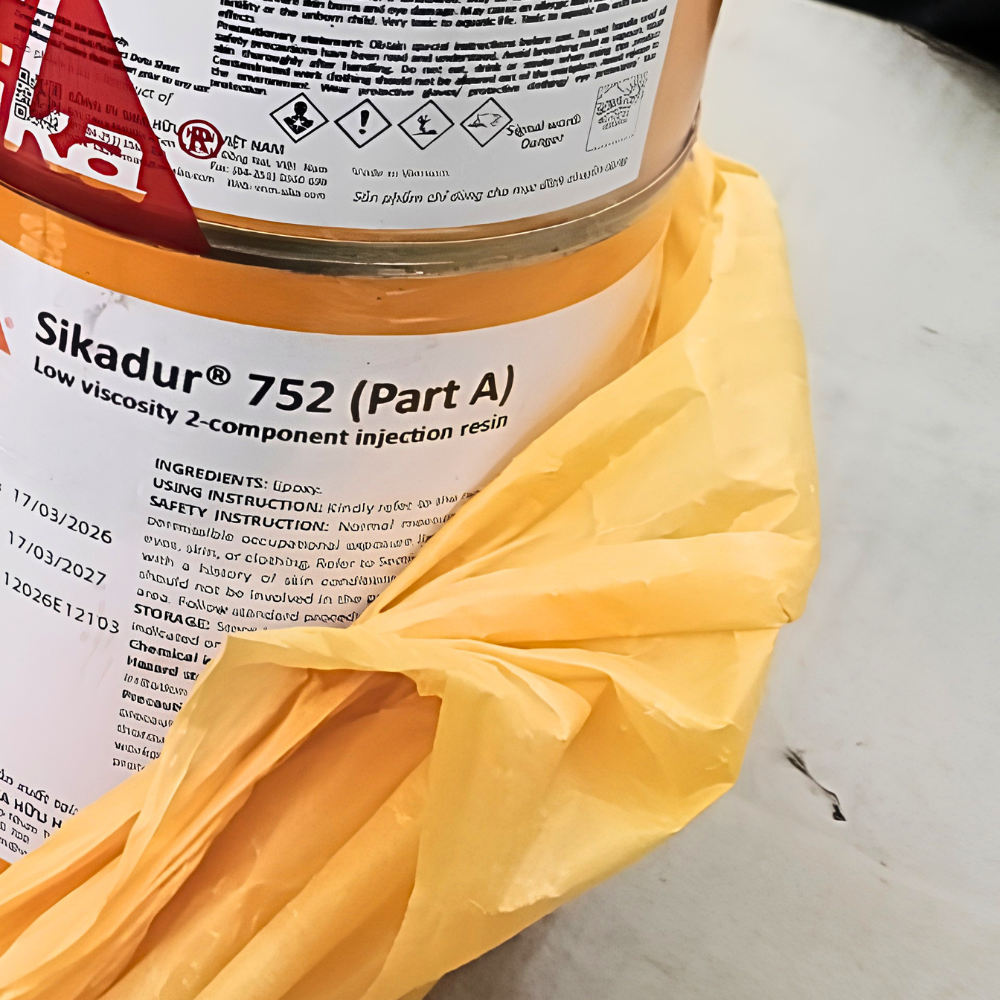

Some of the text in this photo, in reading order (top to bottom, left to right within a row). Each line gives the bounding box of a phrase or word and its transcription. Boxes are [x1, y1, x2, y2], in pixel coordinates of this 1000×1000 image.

[34, 355, 509, 448] Low viscosity 2-component injection resin
[248, 373, 335, 414] 752
[350, 379, 460, 423] (Part
[469, 364, 515, 408] A)
[153, 477, 202, 498] USING
[208, 490, 323, 513] INSTRUCTION:
[154, 457, 269, 489] INGREDIENTS:
[14, 489, 113, 544] 17/03/2026
[150, 495, 207, 518] SAFETY
[214, 509, 329, 533] INSTRUCTION:
[9, 530, 107, 586] 17/03/2027
[5, 572, 120, 634] 12026E12103
